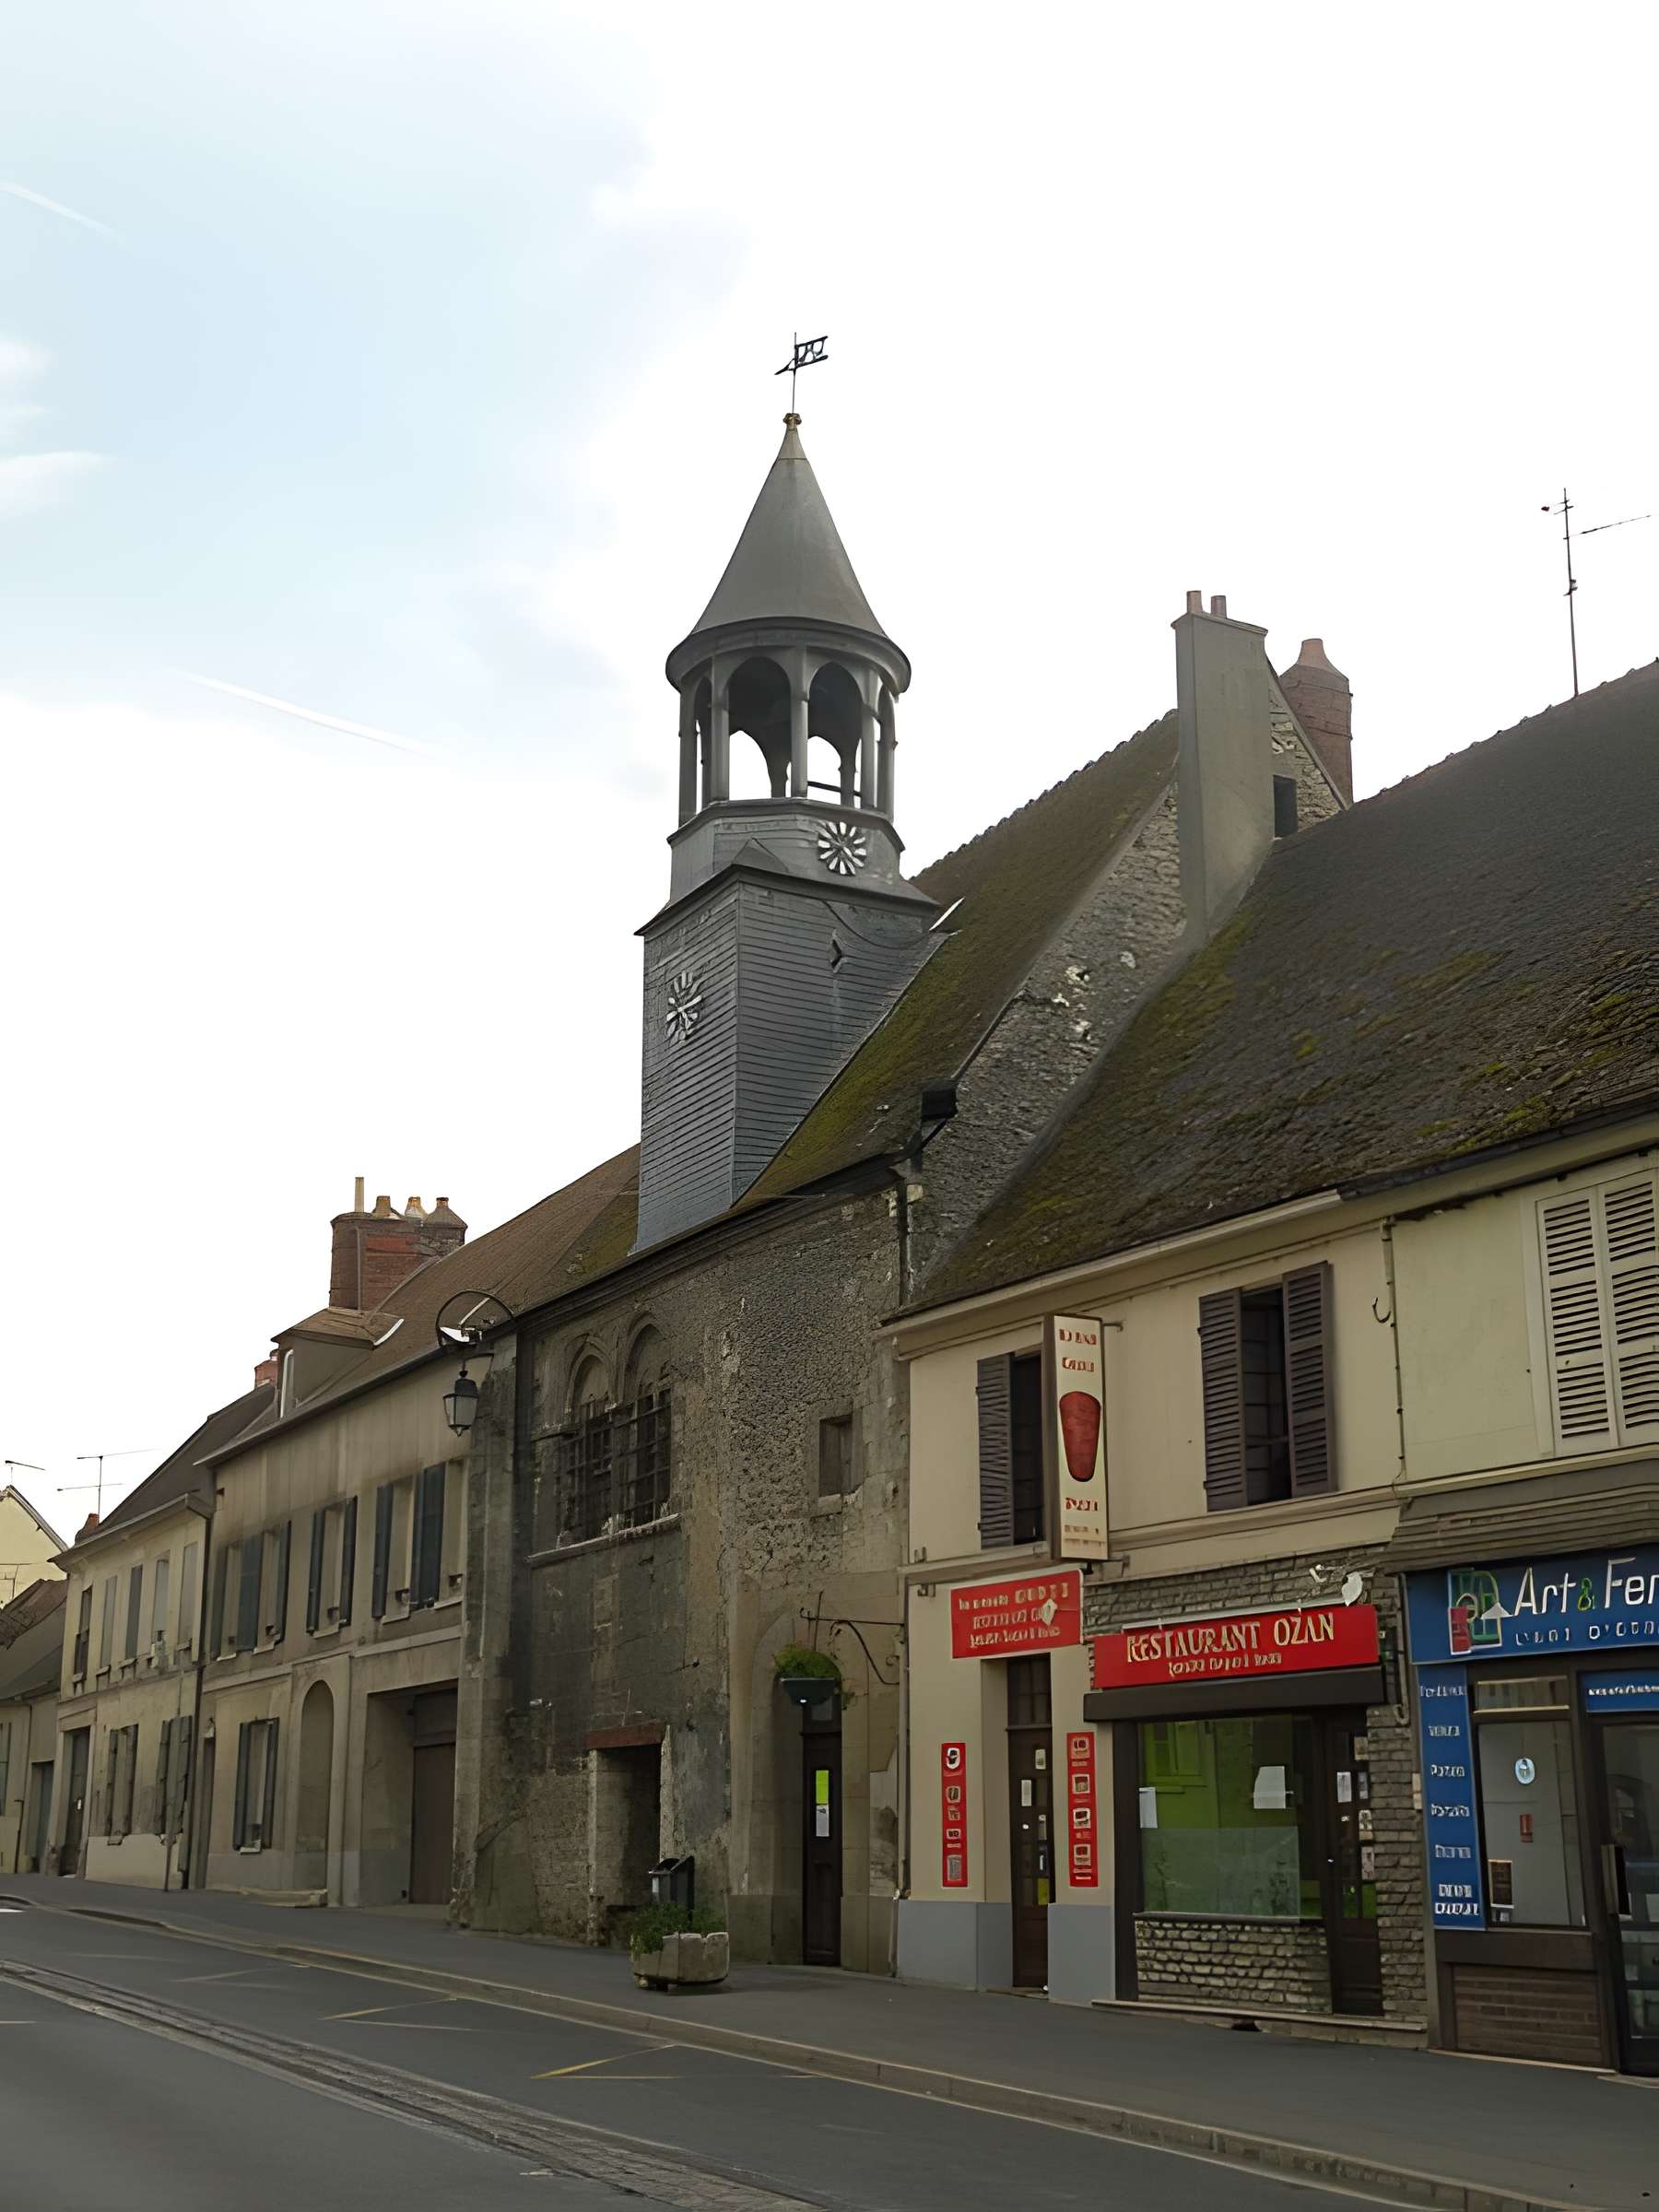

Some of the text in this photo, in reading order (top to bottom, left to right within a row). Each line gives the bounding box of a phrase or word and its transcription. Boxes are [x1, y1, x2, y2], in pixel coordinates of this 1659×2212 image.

[1513, 1567, 1577, 1616] Art
[1577, 1577, 1595, 1611] &
[1126, 1612, 1335, 1663] RESTAURANT OZAN
